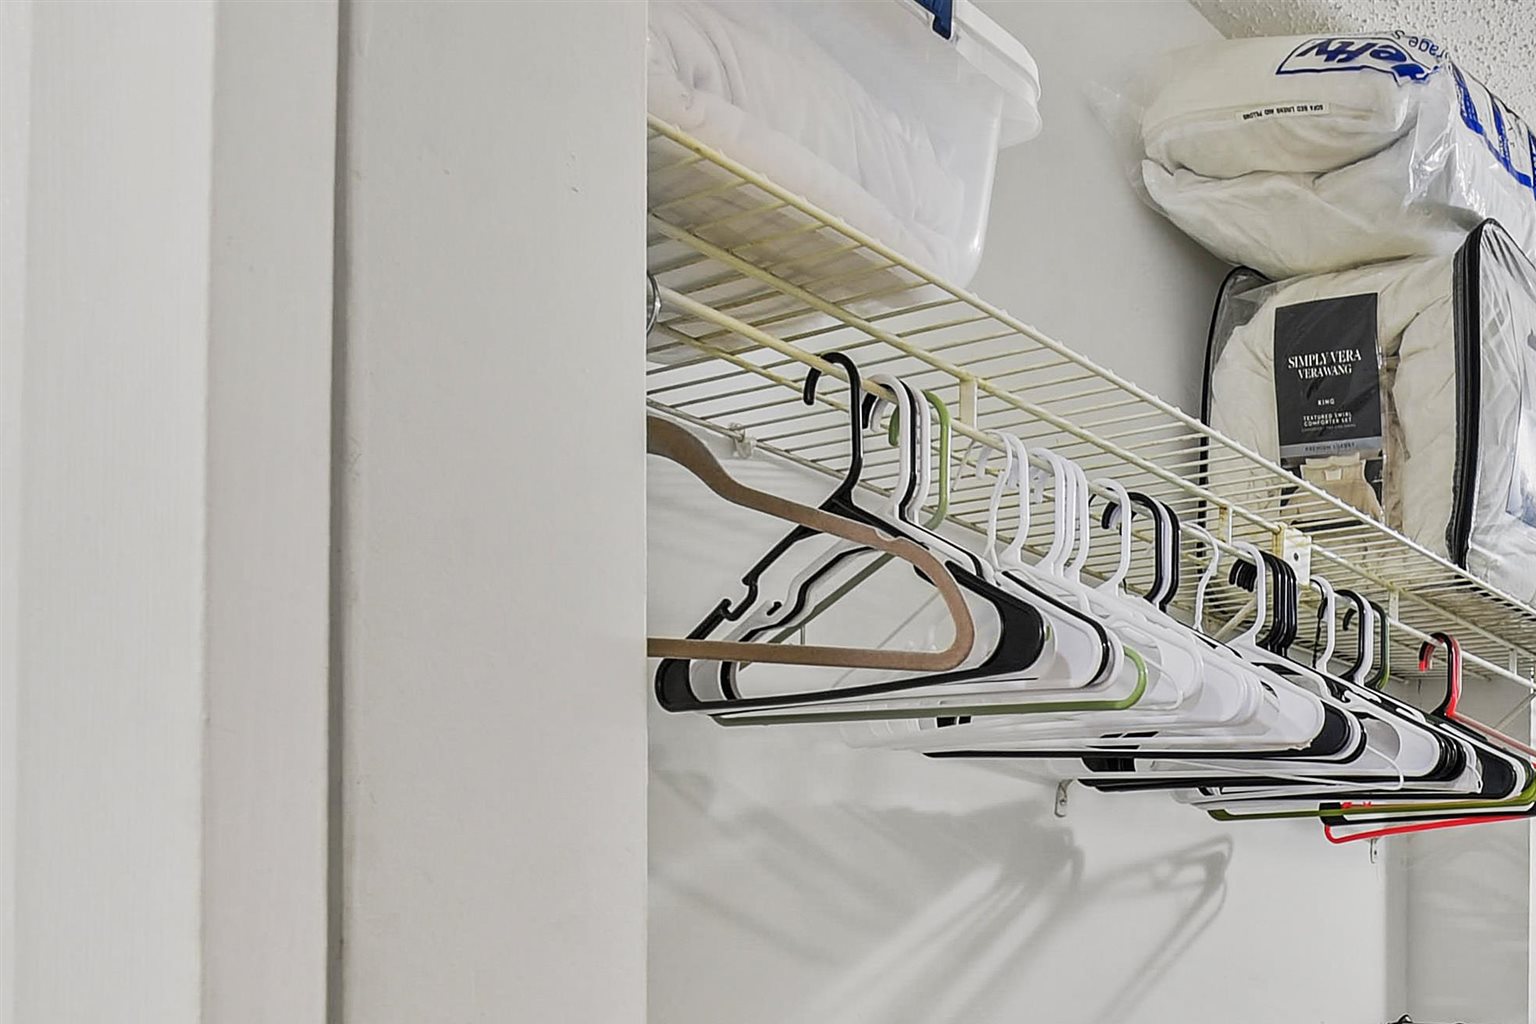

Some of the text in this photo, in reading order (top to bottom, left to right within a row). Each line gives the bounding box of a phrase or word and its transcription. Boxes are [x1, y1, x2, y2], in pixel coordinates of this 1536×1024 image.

[1288, 349, 1362, 369] SIMPLY VERA
[1318, 398, 1335, 406] KING
[1303, 411, 1352, 421] TEXTURED SWIRL
[1303, 418, 1340, 427] COMFORTER
[1305, 444, 1331, 452] PREMIUM
